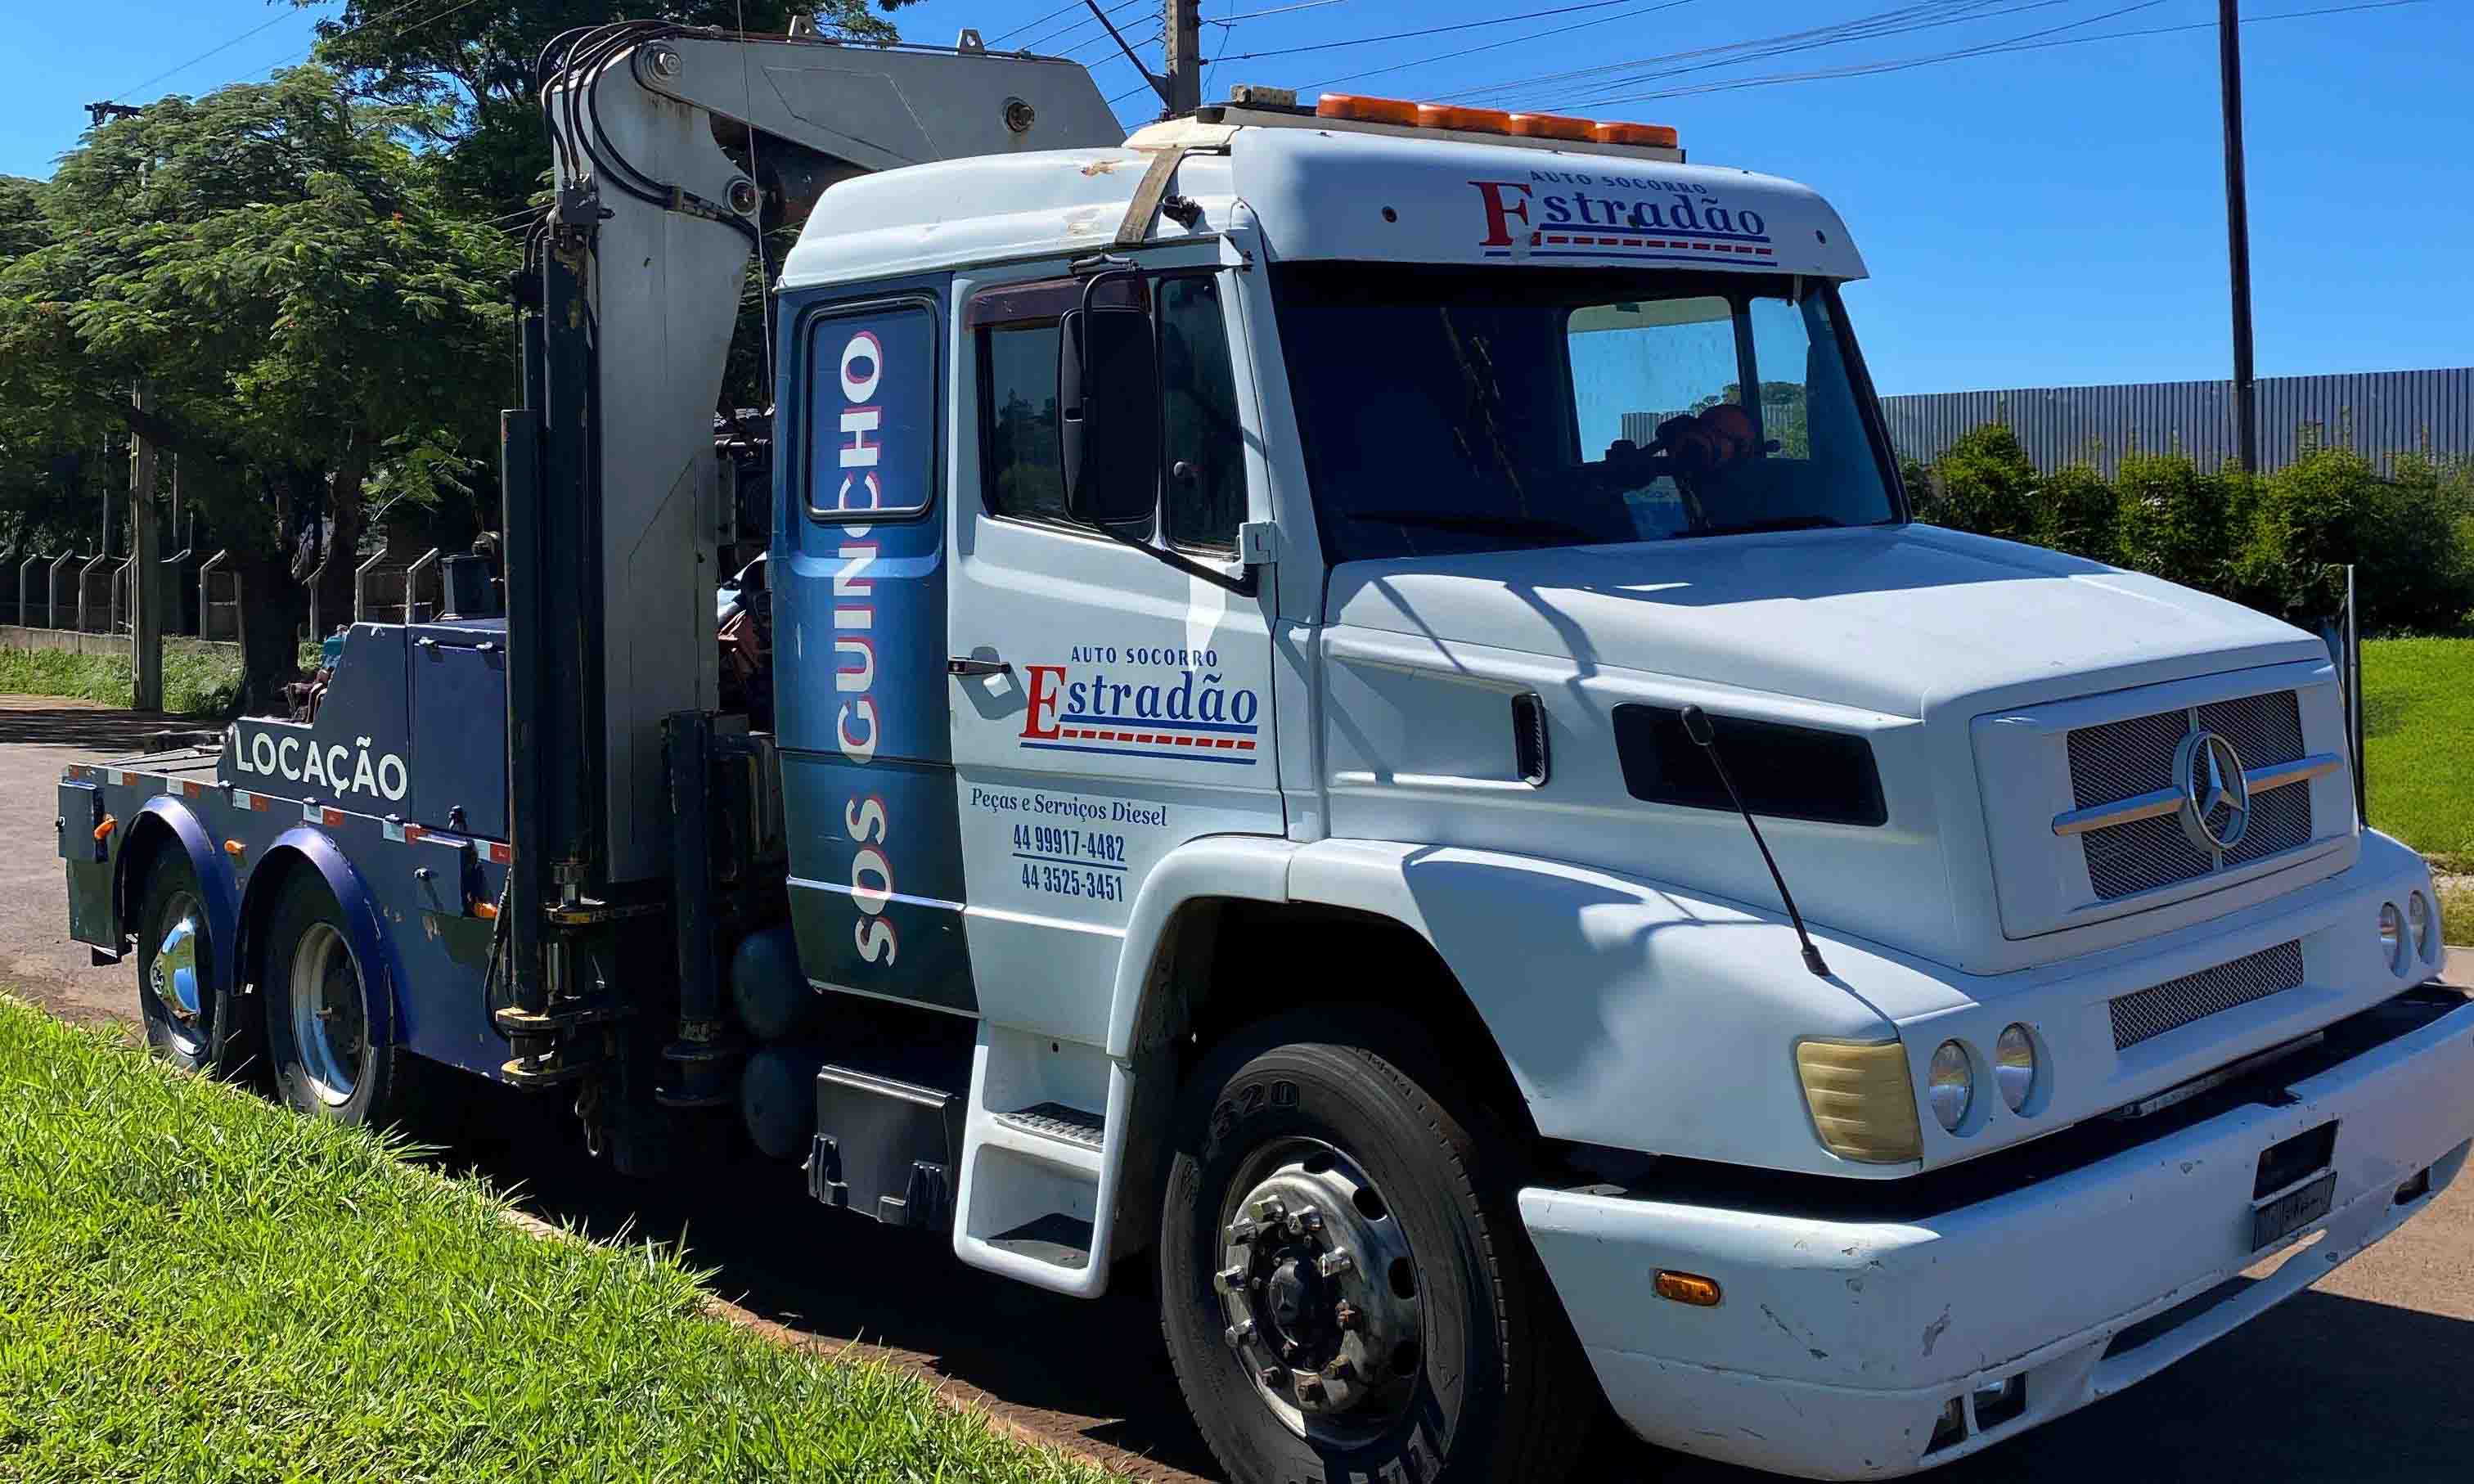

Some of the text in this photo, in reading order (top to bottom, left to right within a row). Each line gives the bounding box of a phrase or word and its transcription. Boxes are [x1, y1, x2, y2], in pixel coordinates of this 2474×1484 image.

[1529, 169, 1707, 195] AUTO SOCORRO
[1467, 180, 1766, 246] Estradão
[834, 331, 897, 969] SOS GUINCHO
[1070, 646, 1217, 668] AUTO SOCORRO
[1019, 665, 1258, 740] Estradão
[234, 728, 407, 801] LOCAÇÃO
[971, 788, 1168, 827] Peças e Serviços Diesel
[1014, 824, 1125, 862] 44 99917-4482
[1022, 863, 1123, 902] 44 3525-3451
